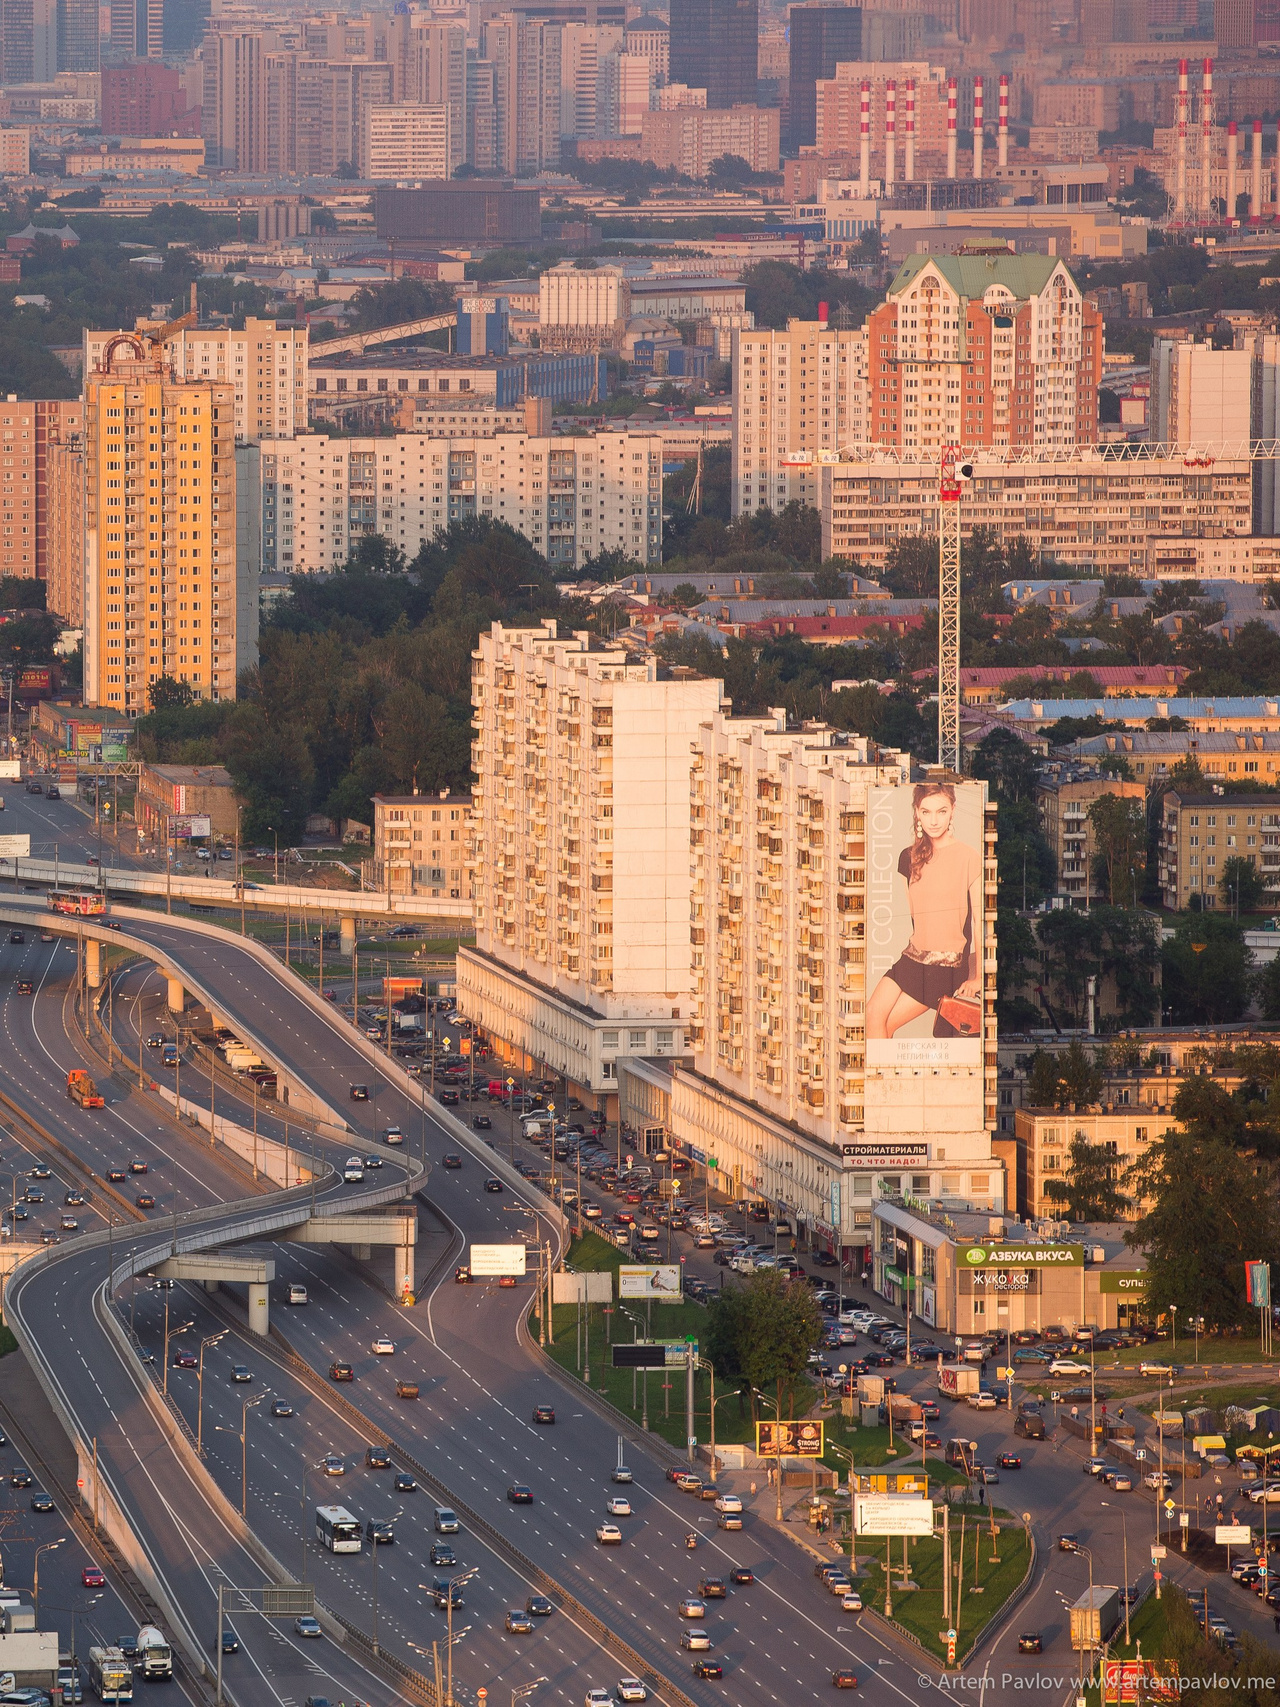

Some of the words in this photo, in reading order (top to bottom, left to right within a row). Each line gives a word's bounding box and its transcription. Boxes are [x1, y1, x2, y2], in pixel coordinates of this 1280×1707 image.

[872, 790, 894, 946] COLLECTION
[872, 954, 894, 974] TJ
[897, 1042, 936, 1050] ТВЕРСКАЯ
[844, 1146, 926, 1154] СТРОЙМАТЕРИАЛЫ
[989, 1251, 1034, 1262] АЗБУКА
[1036, 1251, 1074, 1261] ВКУСА
